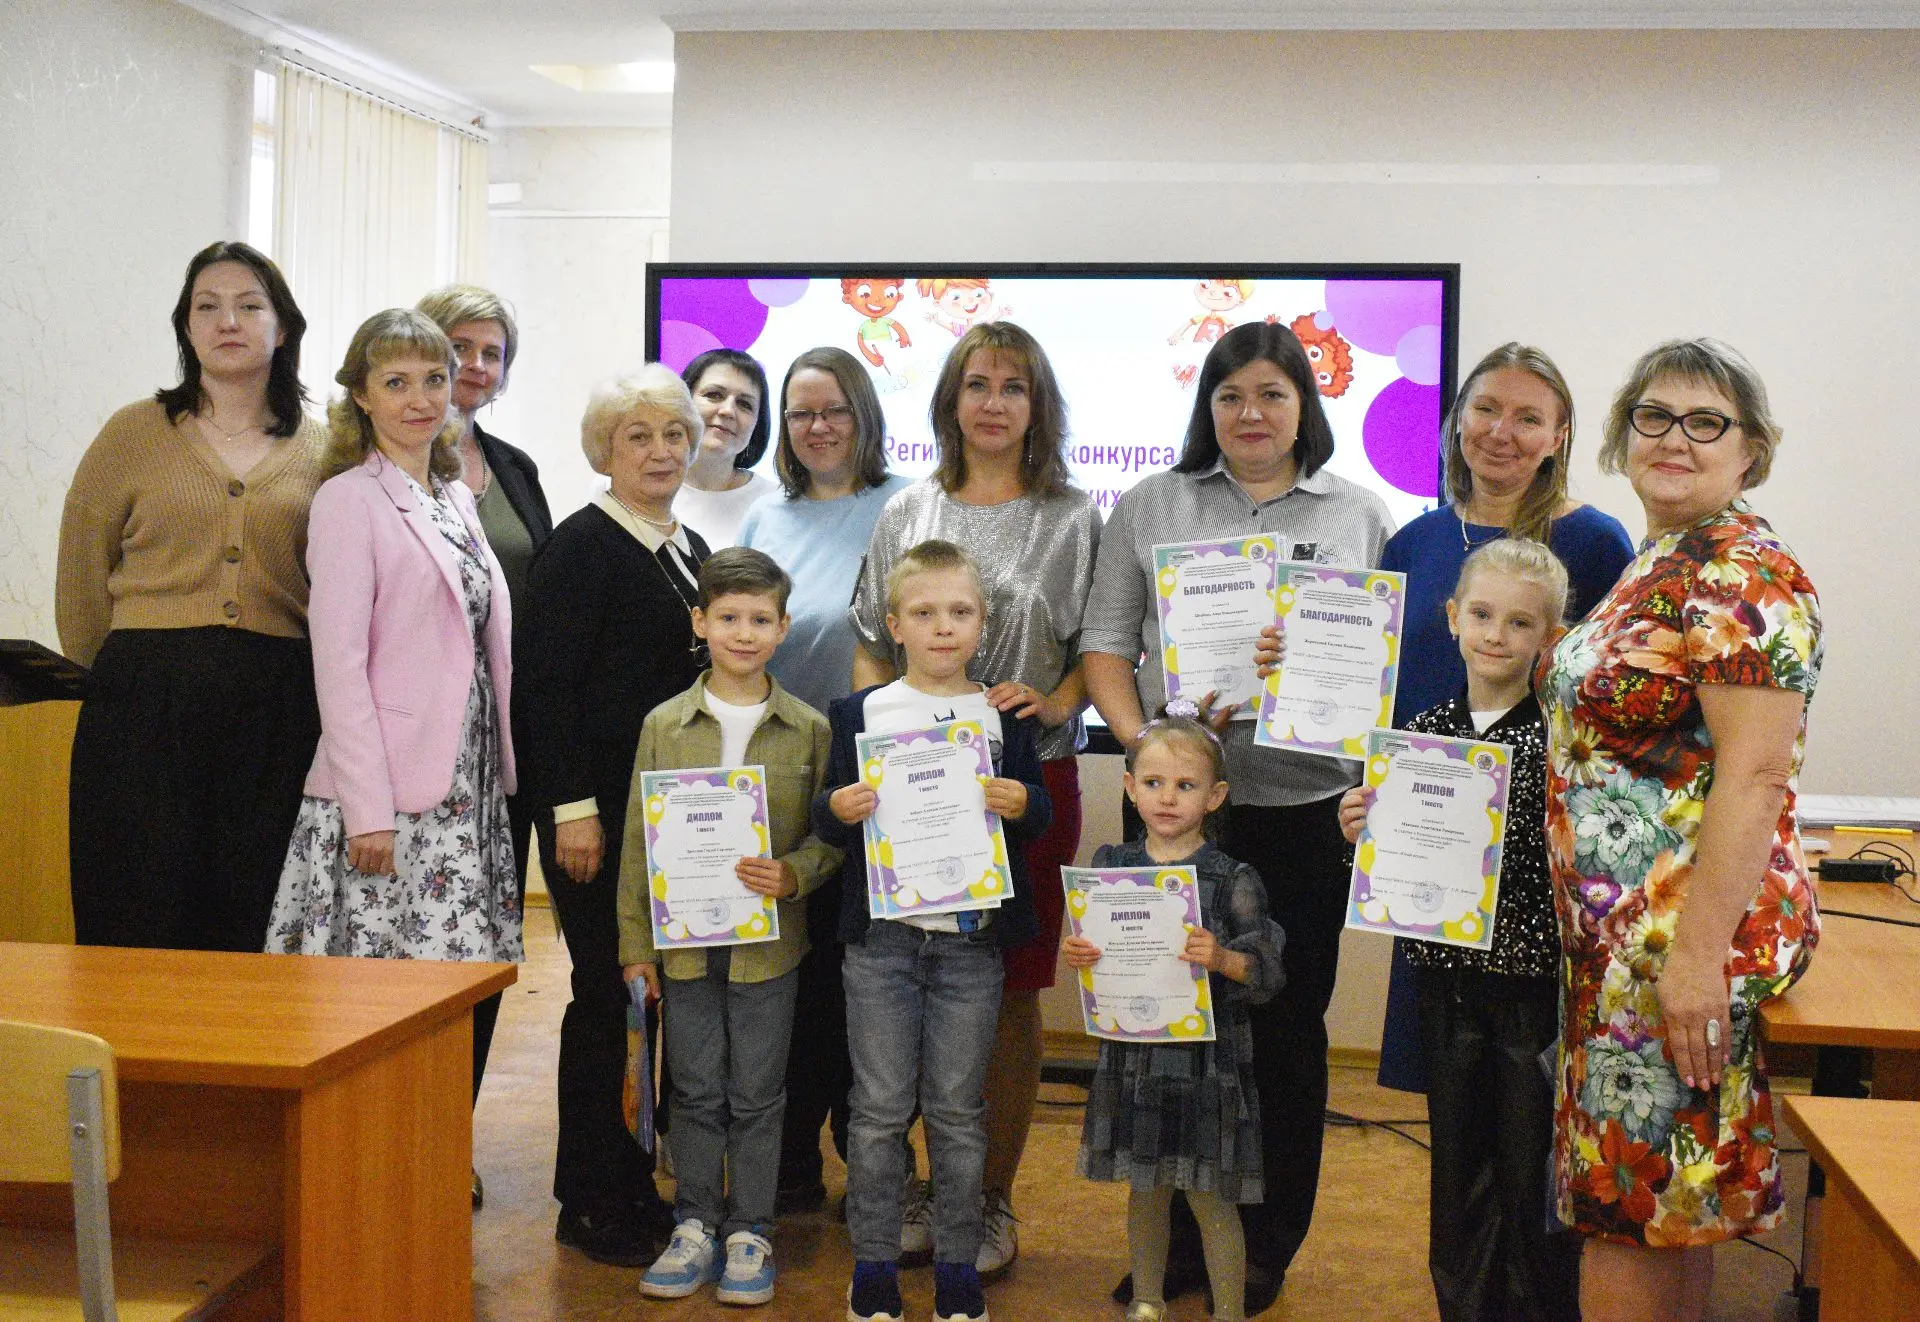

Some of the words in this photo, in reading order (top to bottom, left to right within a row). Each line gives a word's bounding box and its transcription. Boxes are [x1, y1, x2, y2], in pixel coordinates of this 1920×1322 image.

[1183, 580, 1256, 597] БЛАГОДАРНОСТЬ
[1299, 608, 1373, 627] БЛАГОДАРНОСТЬ
[907, 767, 946, 784] ДИПЛОМ
[1411, 781, 1456, 798] ДИПЛОМ
[1425, 800, 1443, 809] место
[686, 811, 724, 824] ДИПЛОМ
[1110, 910, 1151, 923] ДИПЛОМ
